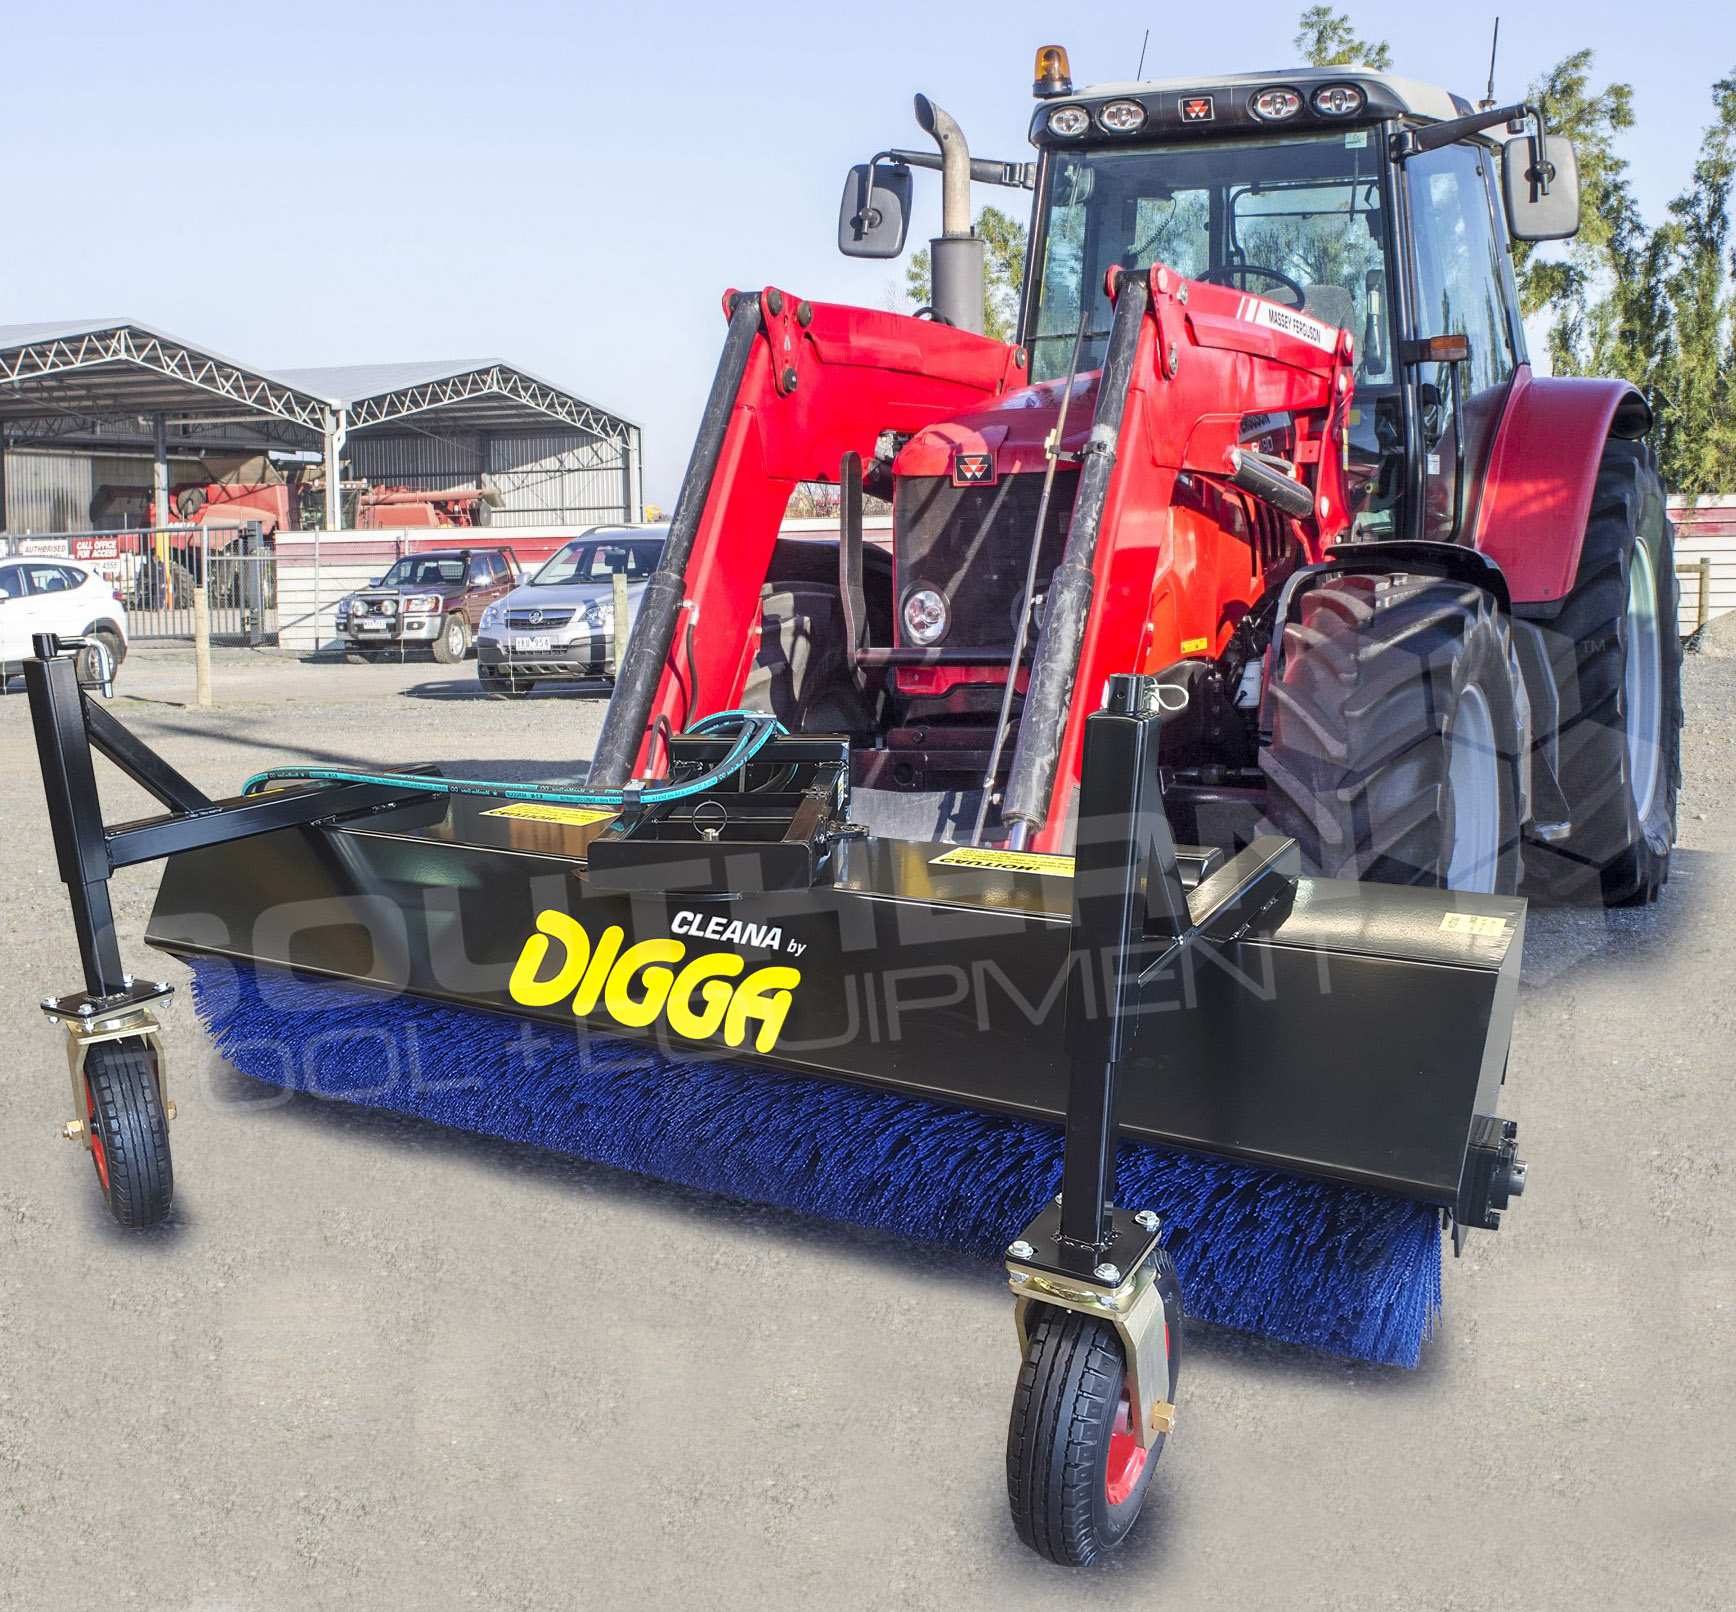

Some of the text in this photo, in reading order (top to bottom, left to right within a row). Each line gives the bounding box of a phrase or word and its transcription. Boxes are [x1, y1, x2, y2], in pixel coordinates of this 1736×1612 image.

[1268, 308, 1321, 344] MASSEY FERGUSON
[25, 544, 67, 553] AUTHORISED
[76, 540, 117, 550] CALL OFFICE
[76, 549, 118, 559] FOR ACCESS
[671, 910, 807, 957] CLEANA by
[508, 909, 801, 1054] DIGGA
